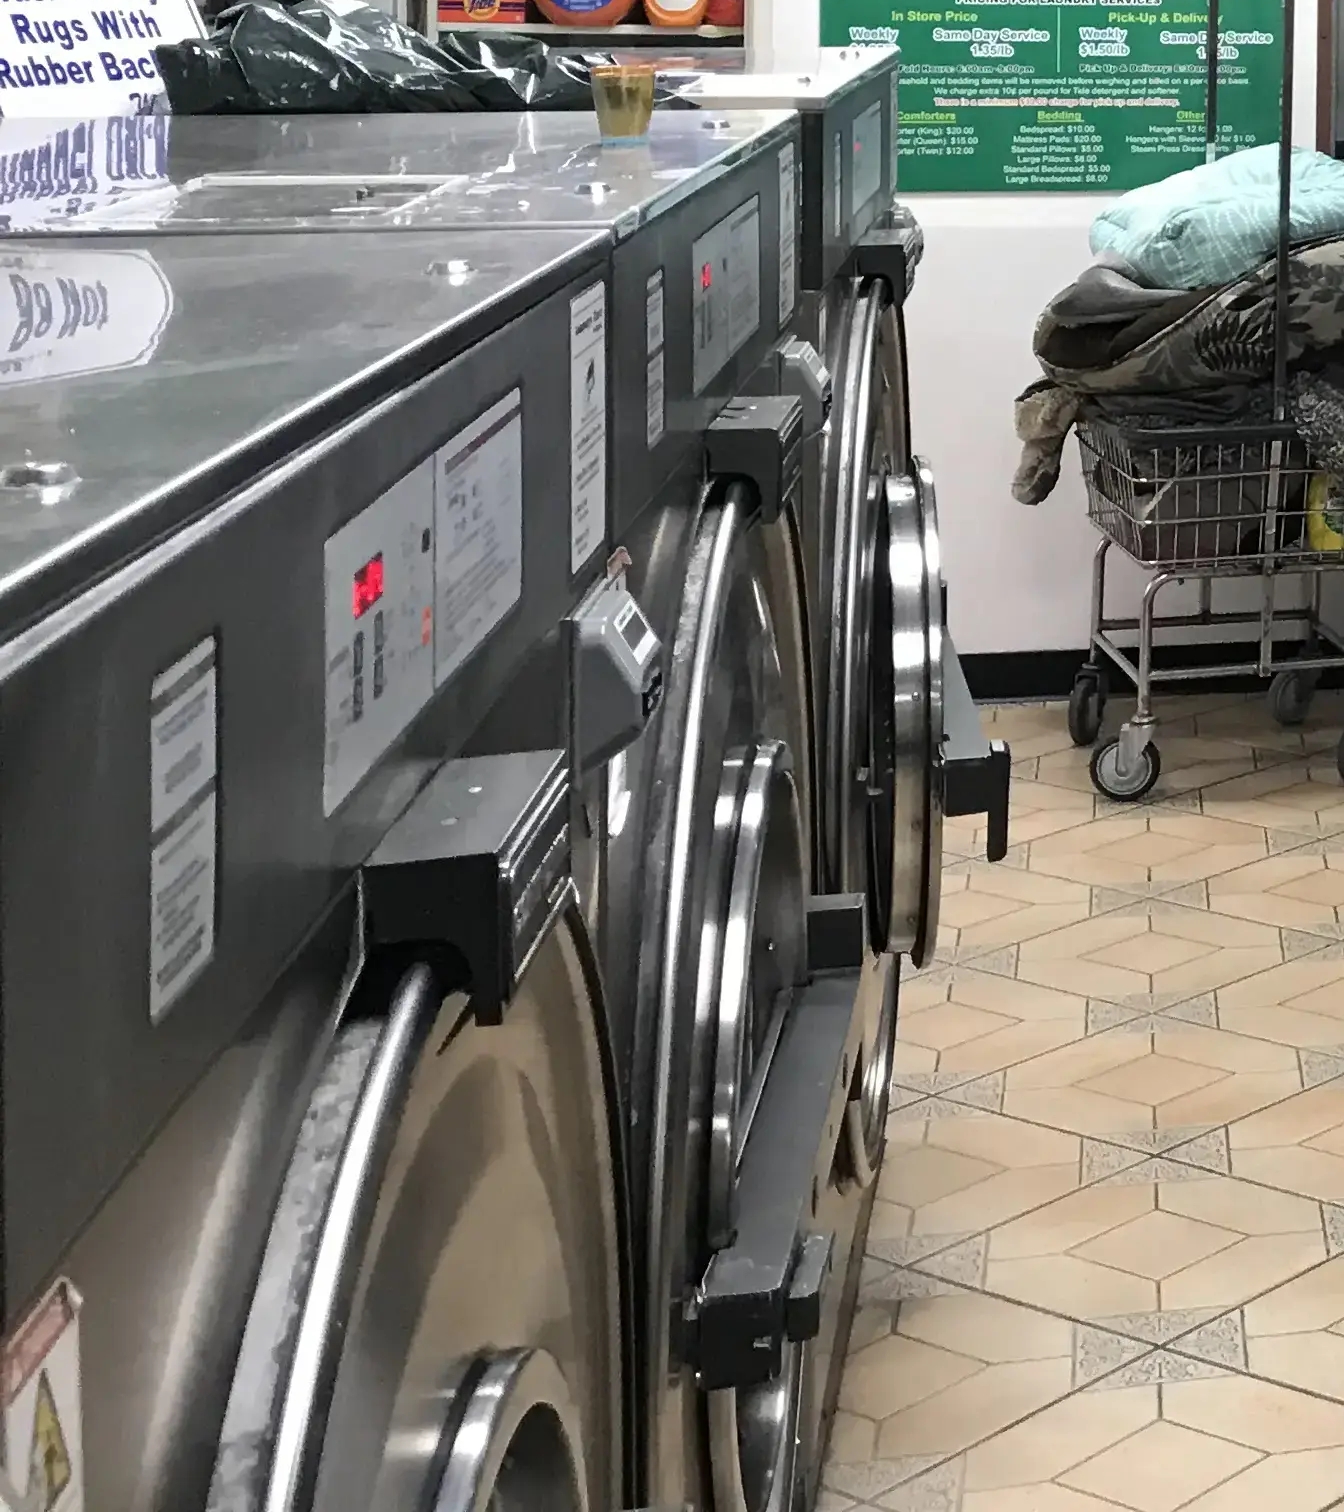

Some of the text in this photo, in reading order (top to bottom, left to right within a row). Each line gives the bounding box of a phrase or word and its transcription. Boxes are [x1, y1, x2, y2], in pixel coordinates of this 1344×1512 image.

[891, 11, 979, 23] In Store Price
[1108, 11, 1224, 26] Pick-Up & Delivey
[9, 9, 163, 51] Rugs With
[849, 27, 1050, 45] Weekly Same Day Service
[1079, 27, 1273, 44] Weekly Same Service
[970, 43, 1014, 57] 1.35/lb
[1079, 43, 1130, 57] $1.50/lb
[0, 54, 95, 89] Rubber
[947, 78, 980, 86] bedding
[934, 87, 948, 95] We
[949, 88, 977, 97] charge
[1033, 88, 1059, 97] pound
[1091, 88, 1130, 97] detergent
[897, 110, 957, 123] Comforters
[1037, 110, 1083, 122] Bedding
[1176, 110, 1206, 122] Other
[1016, 154, 1041, 165] Large
[1005, 175, 1030, 185] Large
